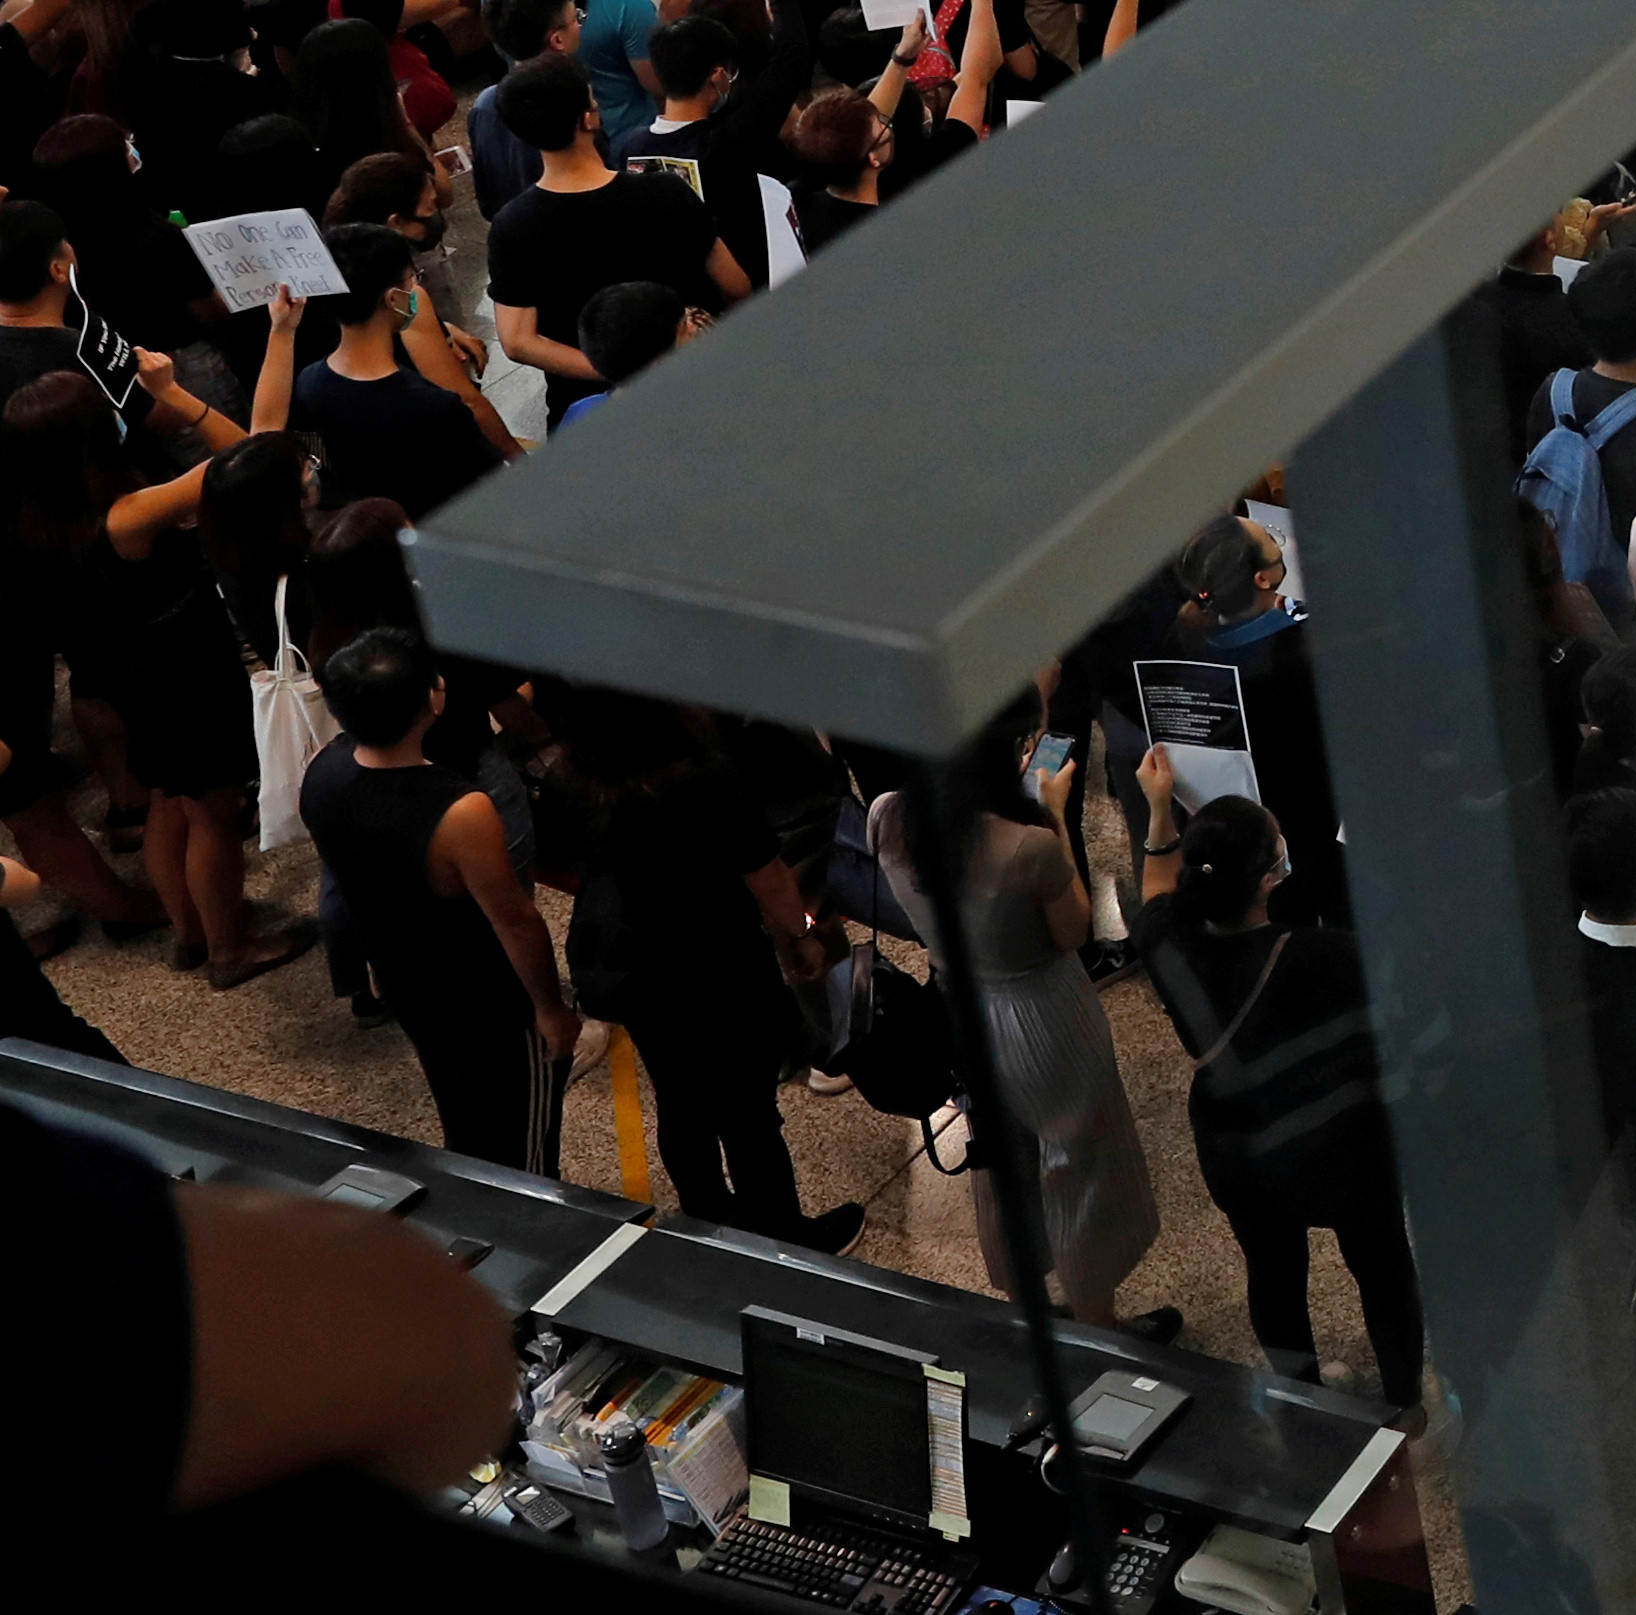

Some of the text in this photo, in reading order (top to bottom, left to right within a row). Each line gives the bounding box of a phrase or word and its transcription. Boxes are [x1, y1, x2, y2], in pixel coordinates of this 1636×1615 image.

[214, 246, 324, 281] Make A Free
